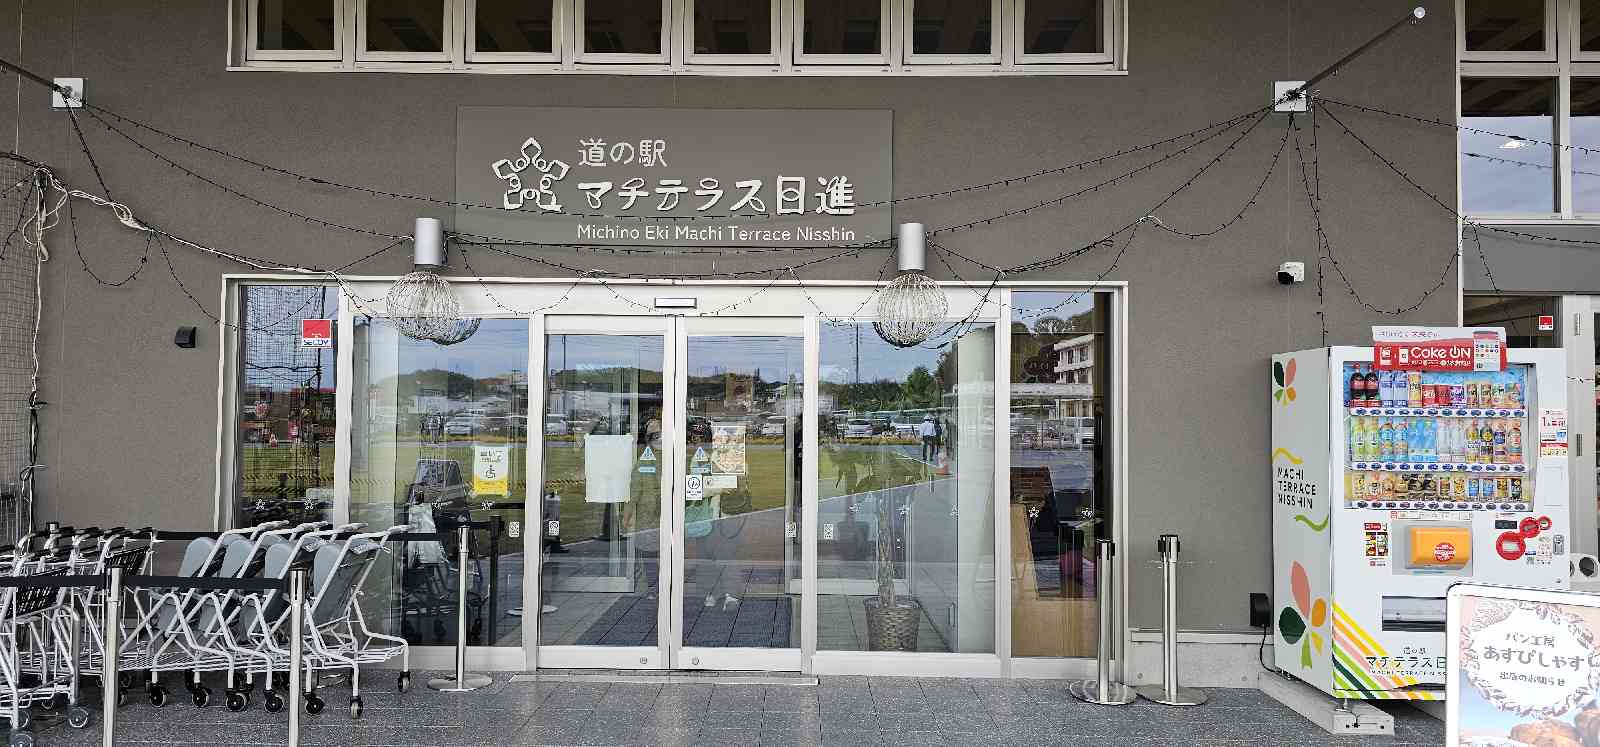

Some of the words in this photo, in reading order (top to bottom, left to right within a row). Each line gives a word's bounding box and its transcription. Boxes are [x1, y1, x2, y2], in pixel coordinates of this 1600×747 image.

[577, 139, 668, 168] 道の駅
[576, 175, 856, 216] マチテラス日進
[577, 224, 640, 240] Michino
[645, 225, 669, 240] Eki
[675, 225, 721, 241] Machi
[727, 226, 791, 241] Terrace
[796, 227, 855, 241] Nisshin
[1410, 346, 1447, 359] Coke
[1449, 345, 1471, 359] ON
[1277, 467, 1304, 481] MACHI
[1277, 480, 1316, 496] TERRACE
[1277, 493, 1312, 509] NISSHIN
